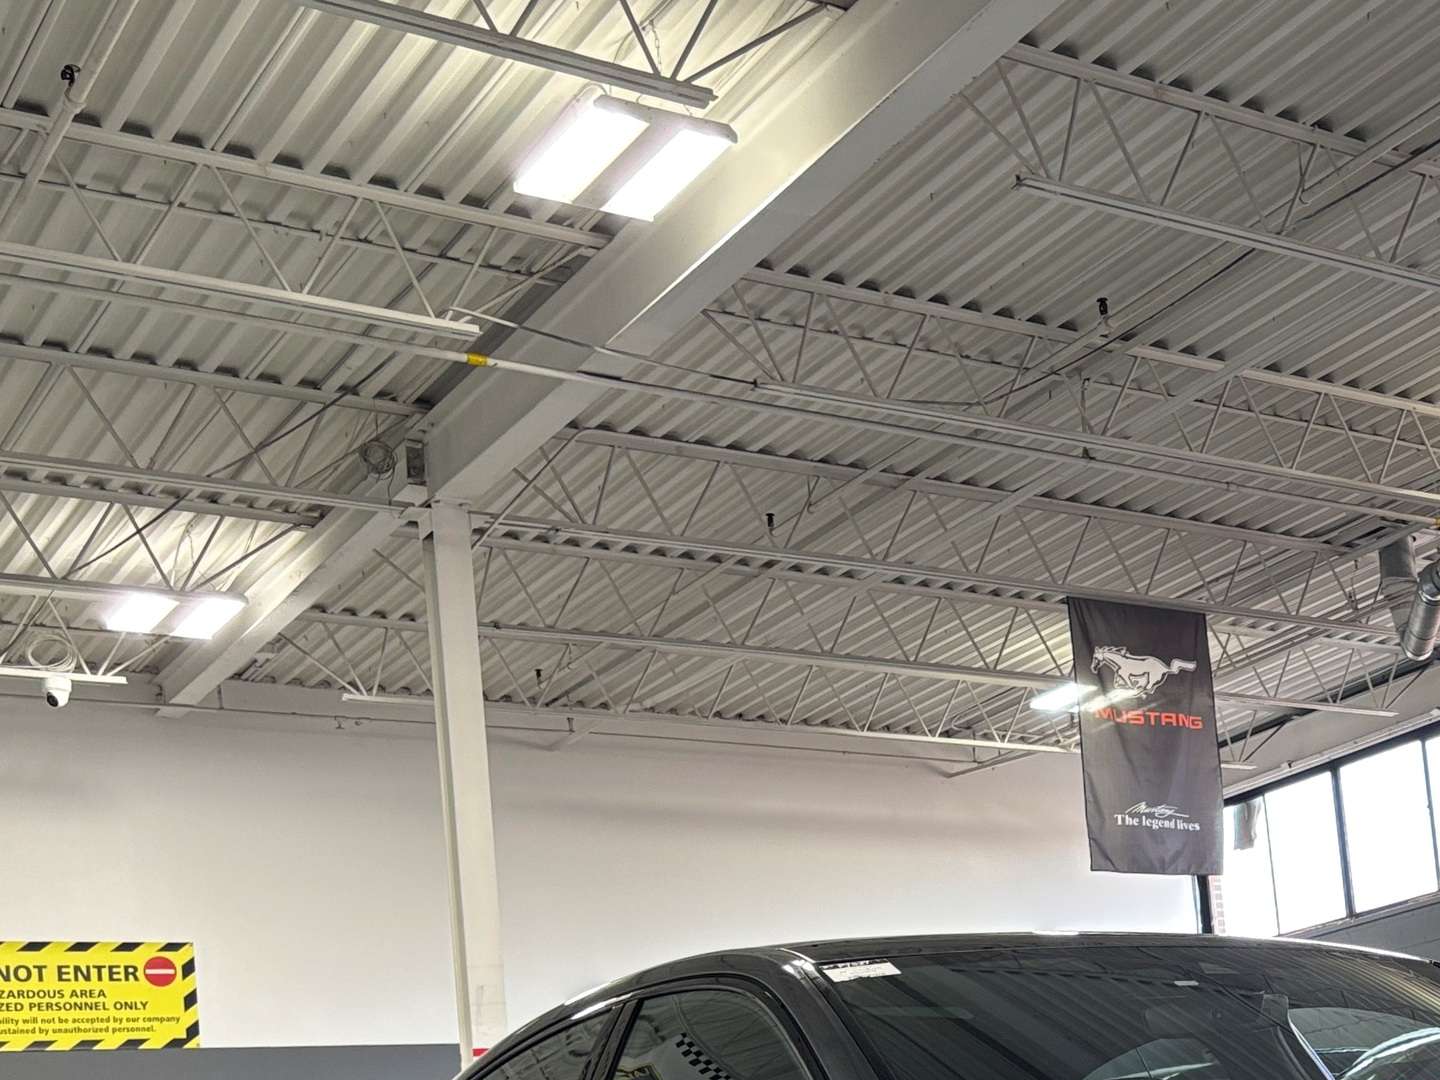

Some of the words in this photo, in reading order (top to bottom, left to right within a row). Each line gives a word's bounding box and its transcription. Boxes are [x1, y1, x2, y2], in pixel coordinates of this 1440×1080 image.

[1095, 706, 1203, 731] MUSTANG
[1114, 814, 1139, 826] The
[1142, 815, 1175, 830] legend
[1177, 819, 1201, 831] lives
[0, 965, 47, 982] NOT
[57, 965, 140, 982] ENTER
[69, 988, 107, 999] AREA
[29, 1001, 109, 1012] PERSONNEL
[113, 1000, 149, 1011] ONLY
[22, 1016, 38, 1024] will
[58, 1016, 69, 1024] be
[72, 1015, 110, 1025] accepted
[113, 1016, 123, 1025] by
[142, 1016, 181, 1024] company
[38, 1027, 49, 1036] by
[52, 1026, 110, 1034] unauthorized
